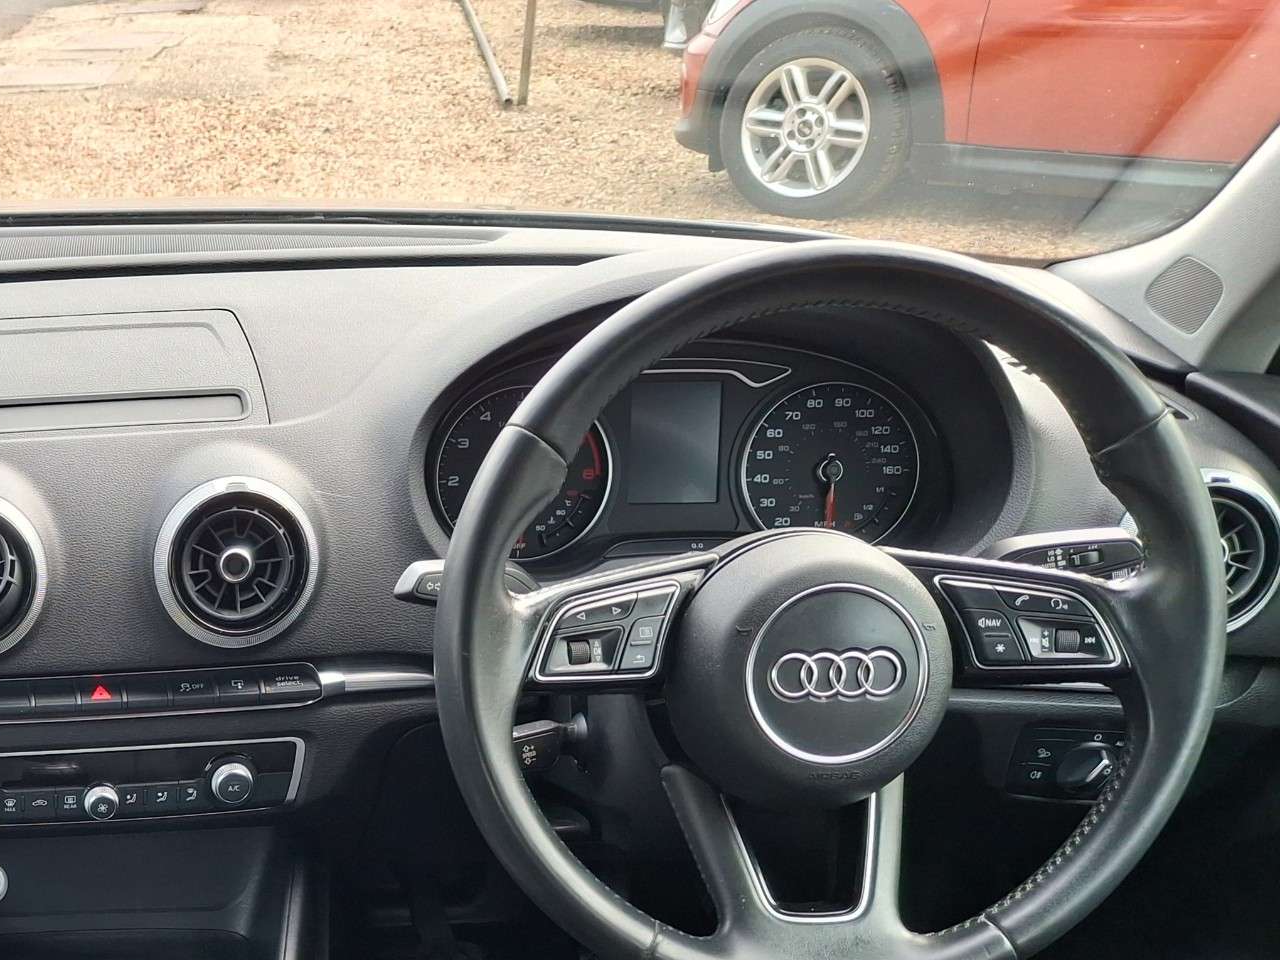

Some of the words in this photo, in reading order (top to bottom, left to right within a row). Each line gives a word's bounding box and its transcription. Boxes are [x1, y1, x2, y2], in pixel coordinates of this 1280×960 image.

[806, 400, 823, 408] 80
[834, 398, 852, 407] 90
[480, 412, 491, 422] 4
[784, 412, 801, 420] 70
[855, 409, 874, 418] 100
[766, 429, 783, 438] 60
[872, 426, 890, 434] 120
[458, 438, 469, 448] 3
[880, 445, 899, 453] 140
[756, 450, 773, 460] 50
[882, 466, 902, 474] 160
[448, 476, 460, 486] 2
[754, 474, 770, 483] 40
[760, 498, 776, 507] 30
[774, 518, 790, 526] 20
[986, 618, 1002, 627] NAV
[228, 784, 240, 792] A/C
